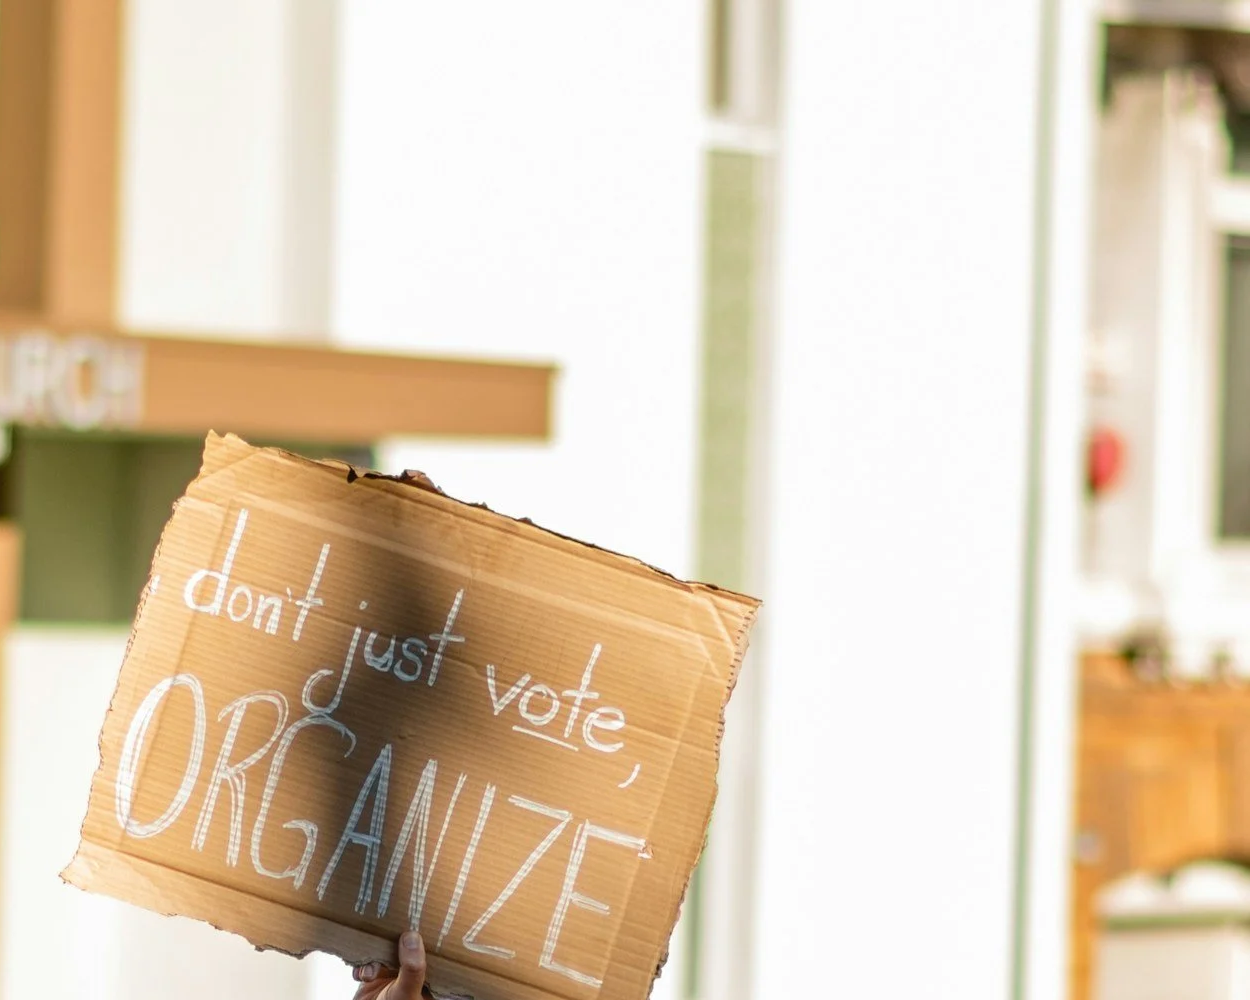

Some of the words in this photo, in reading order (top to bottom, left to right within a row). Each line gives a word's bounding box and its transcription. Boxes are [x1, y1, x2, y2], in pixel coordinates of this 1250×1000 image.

[183, 508, 332, 641] don't
[302, 588, 466, 715] just
[115, 673, 653, 987] ORGANIZE
